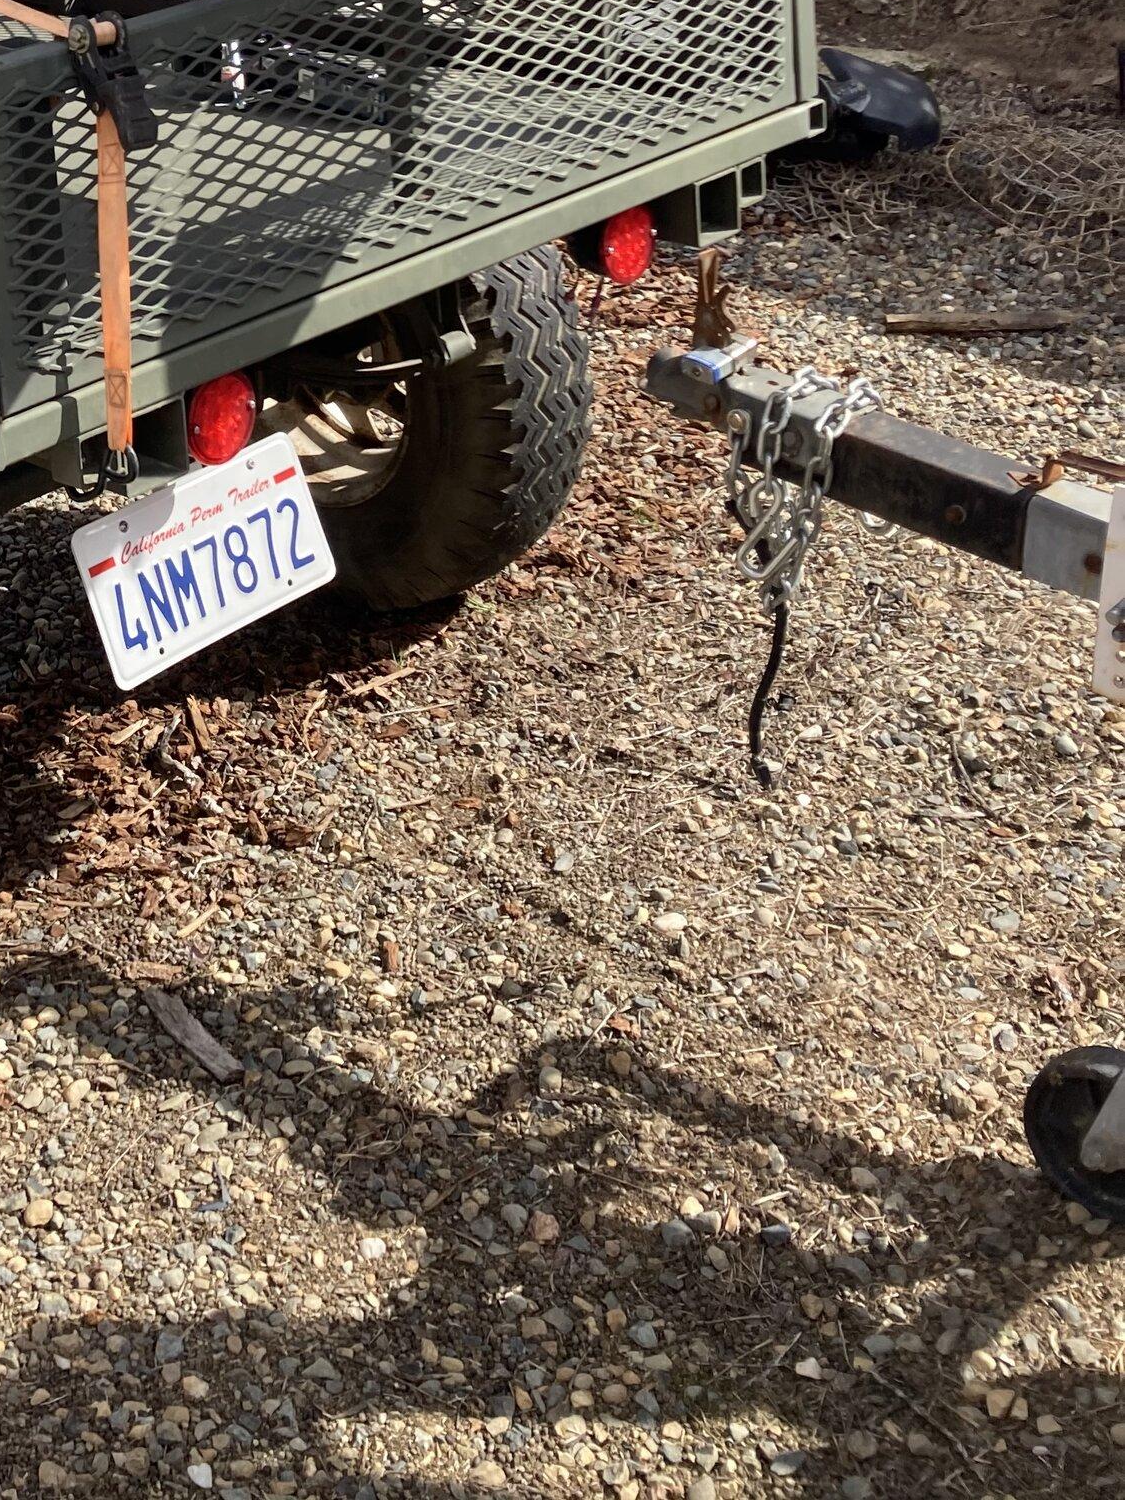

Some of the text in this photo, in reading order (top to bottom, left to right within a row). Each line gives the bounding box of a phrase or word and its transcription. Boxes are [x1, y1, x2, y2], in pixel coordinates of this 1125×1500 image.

[114, 498, 315, 650] 4NM7872
[120, 477, 271, 564] California Perm Trailer
